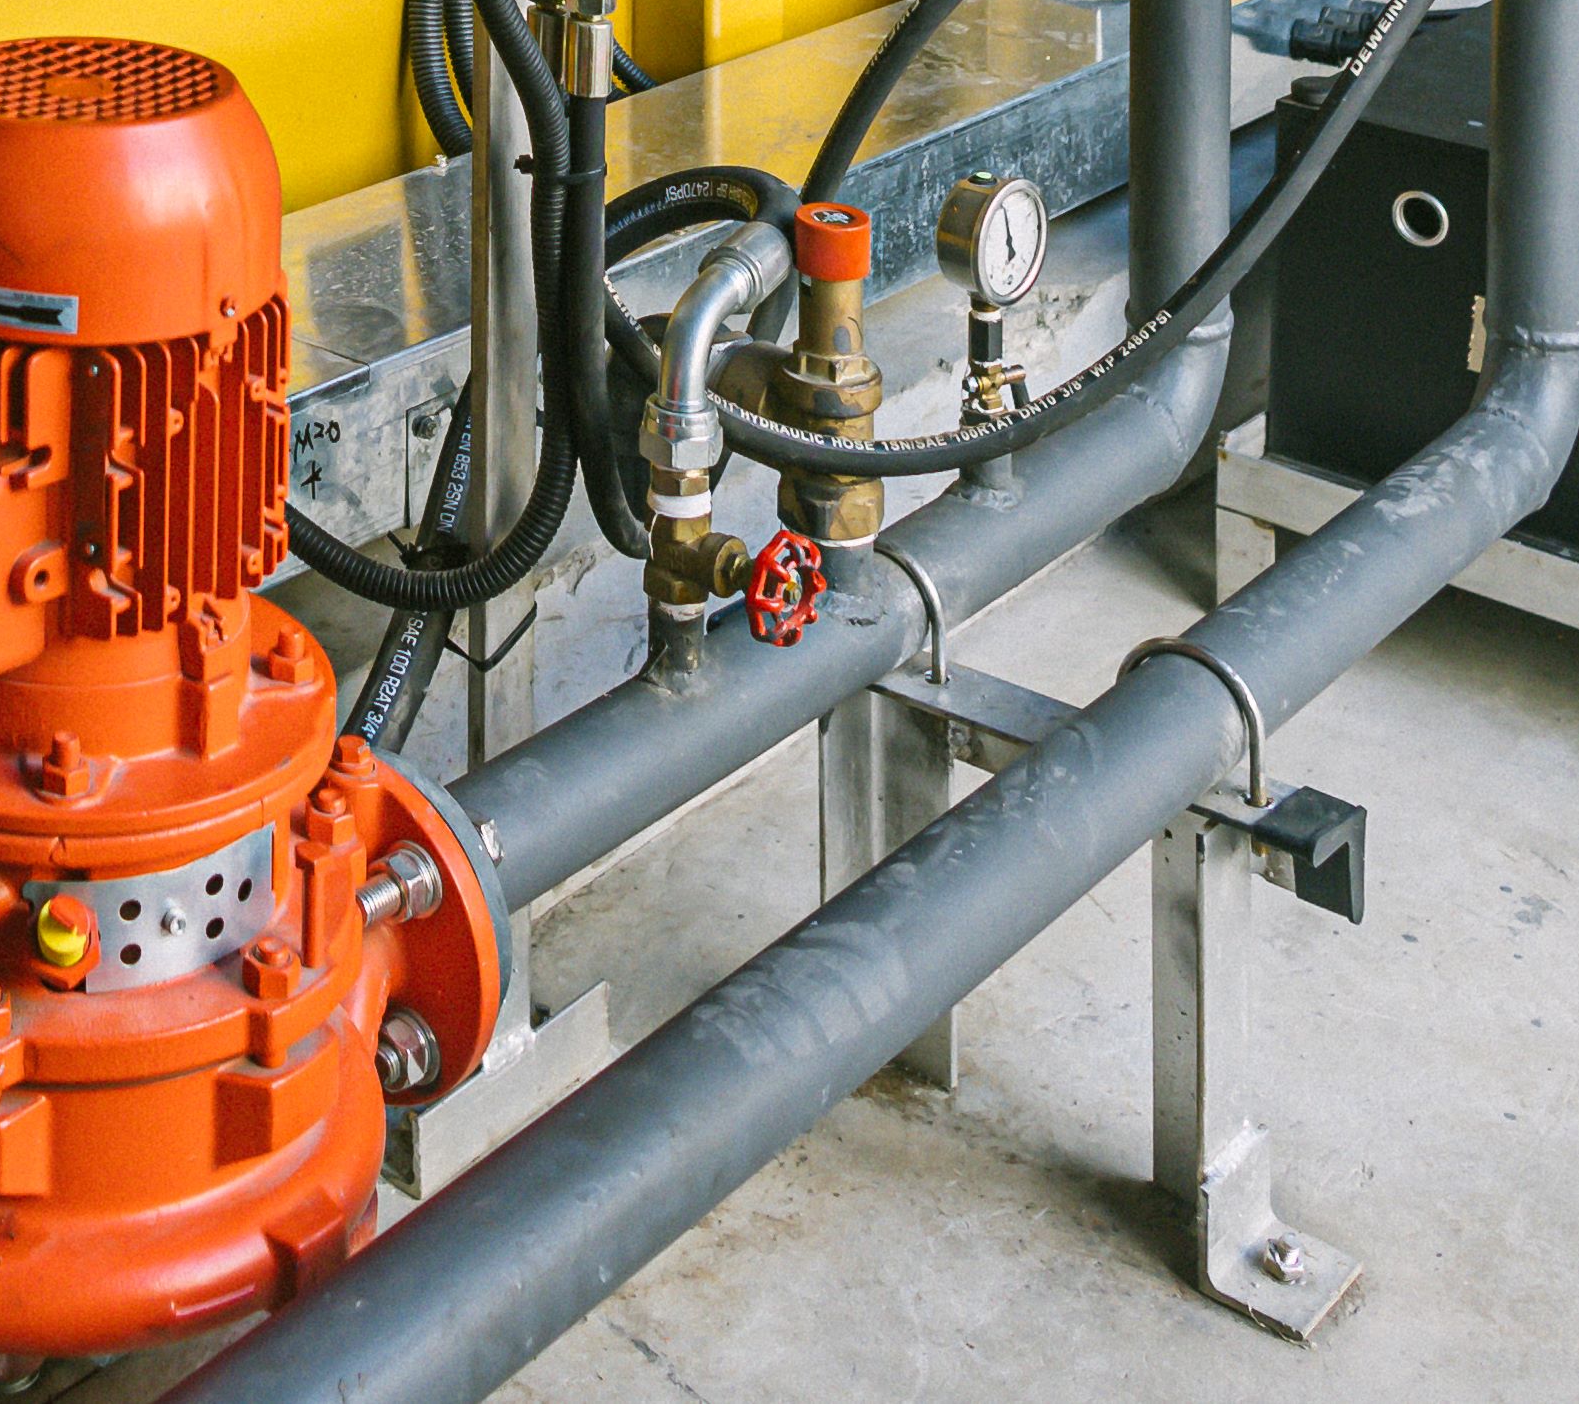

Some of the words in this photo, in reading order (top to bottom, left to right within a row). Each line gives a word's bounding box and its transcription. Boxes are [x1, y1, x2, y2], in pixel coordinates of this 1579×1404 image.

[739, 407, 825, 447] HYDRAULIC
[831, 435, 875, 452] HOSE
[1018, 393, 1058, 419] DN10
[452, 450, 472, 480] 853
[401, 619, 425, 648] SAE
[391, 647, 410, 674] 100
[372, 673, 403, 715] R2AT
